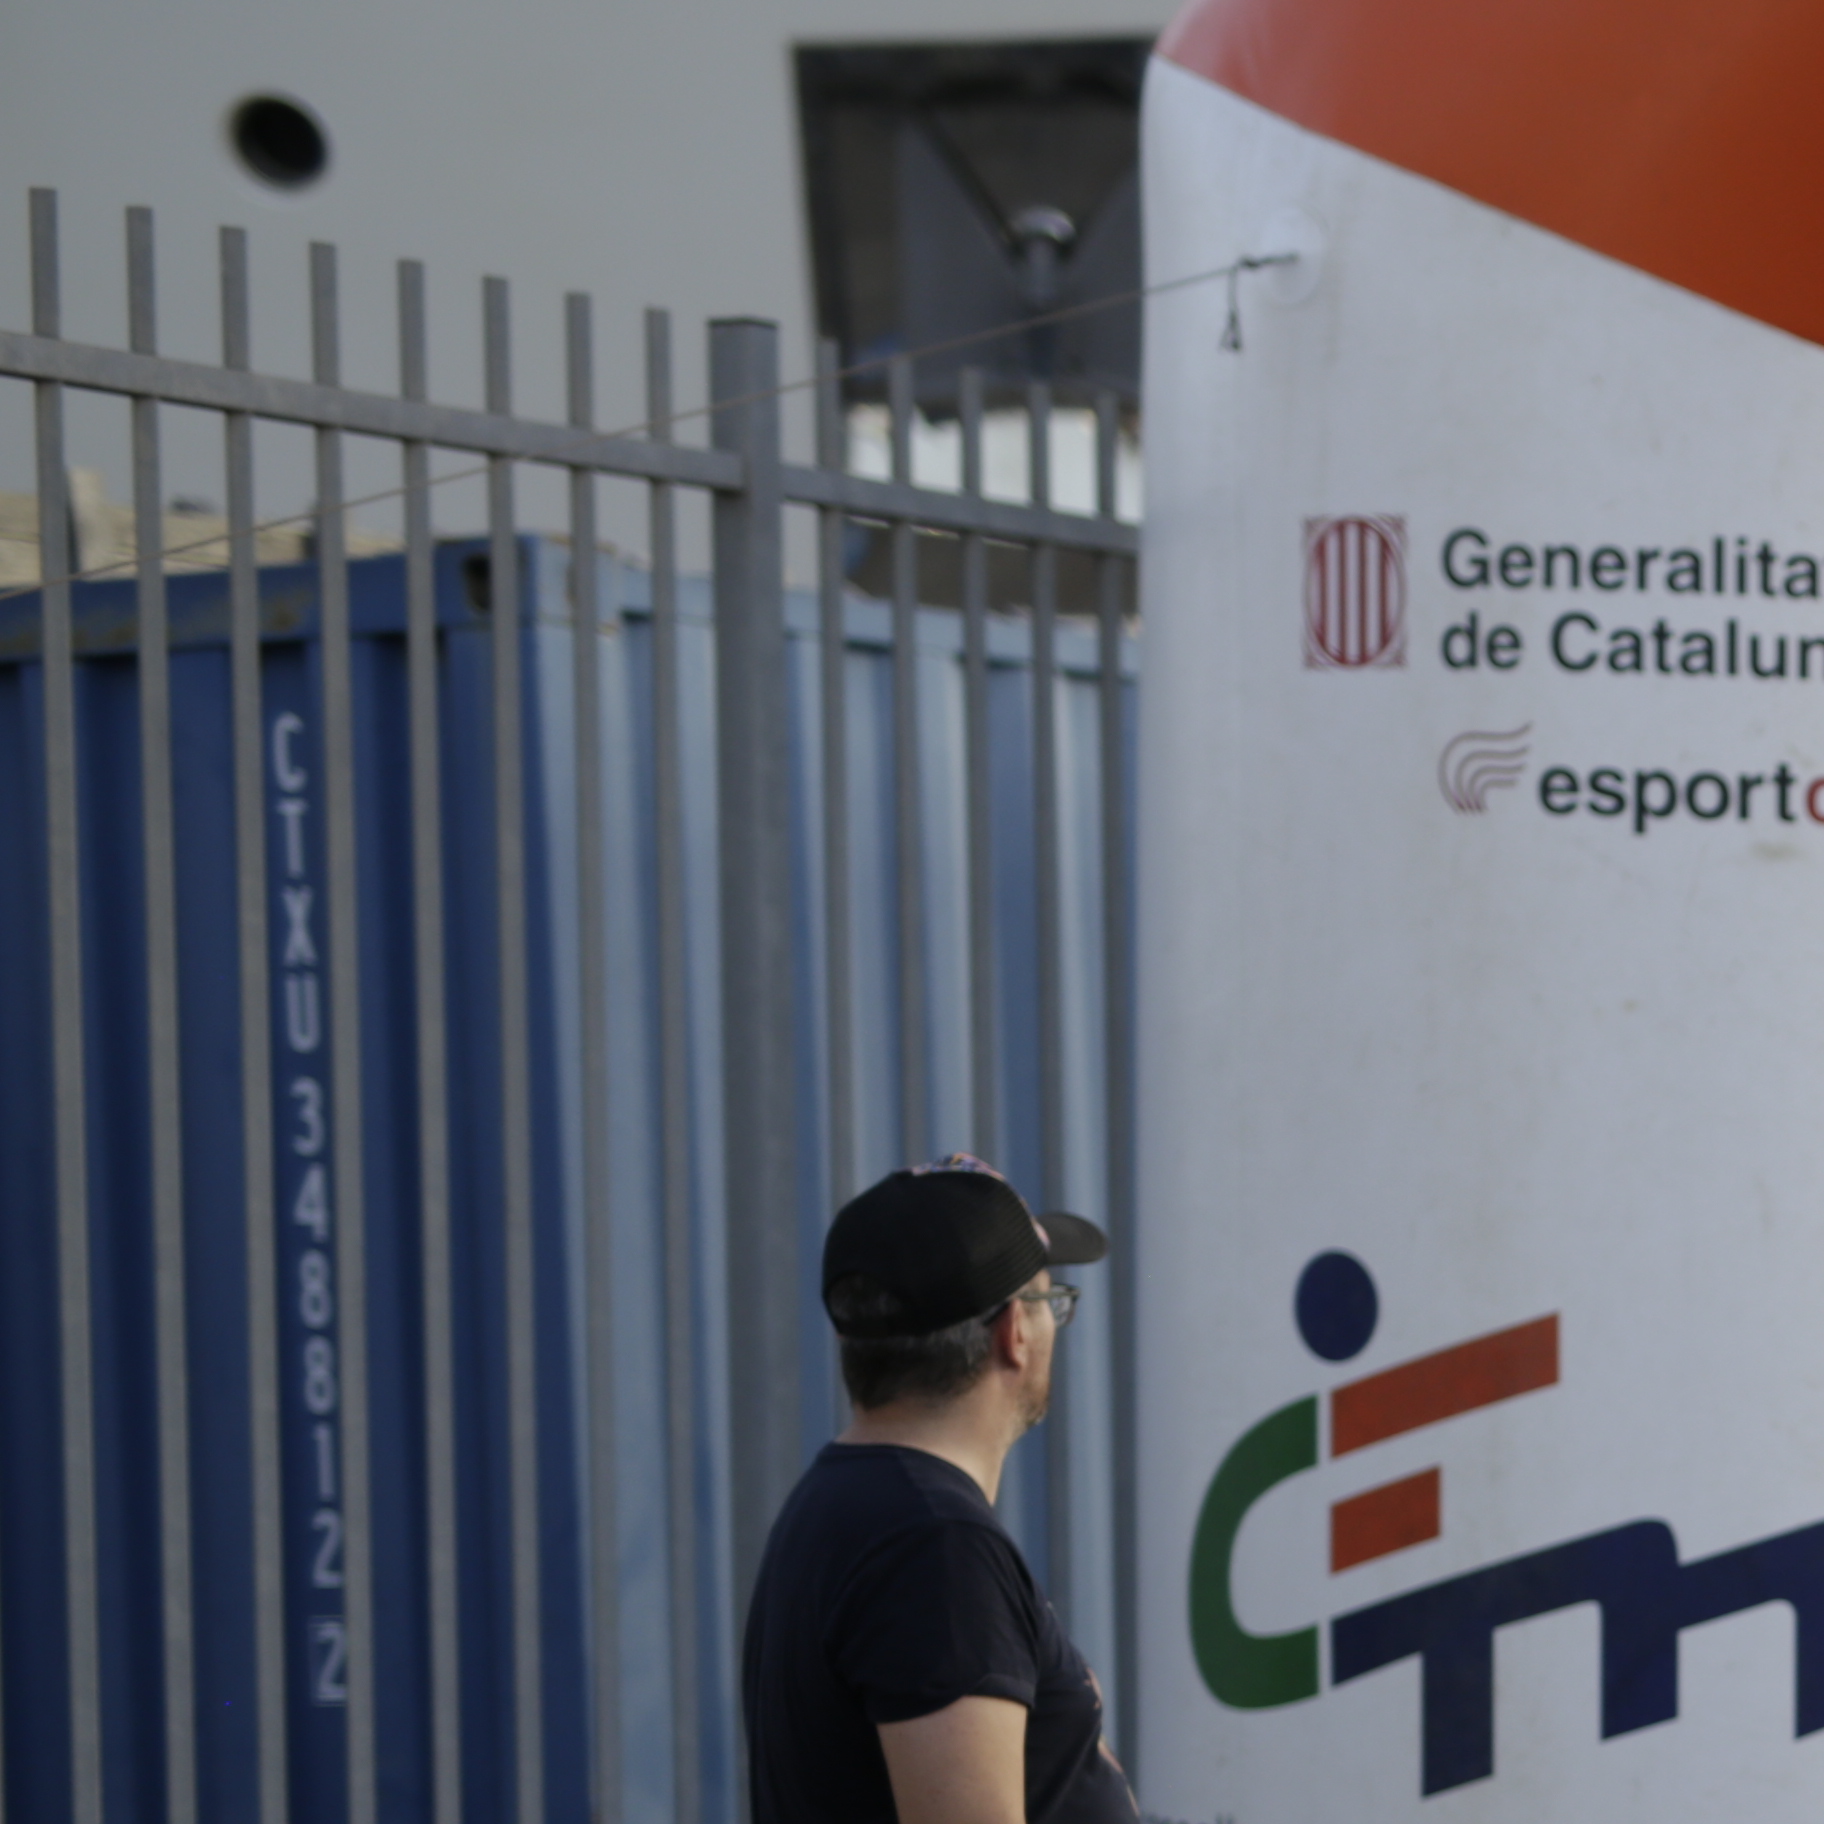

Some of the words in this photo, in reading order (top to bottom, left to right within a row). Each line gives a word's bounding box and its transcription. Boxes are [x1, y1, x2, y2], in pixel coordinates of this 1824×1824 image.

[1441, 611, 1524, 670] de
[272, 710, 322, 1053] CTXU
[292, 1074, 344, 1589] 348812
